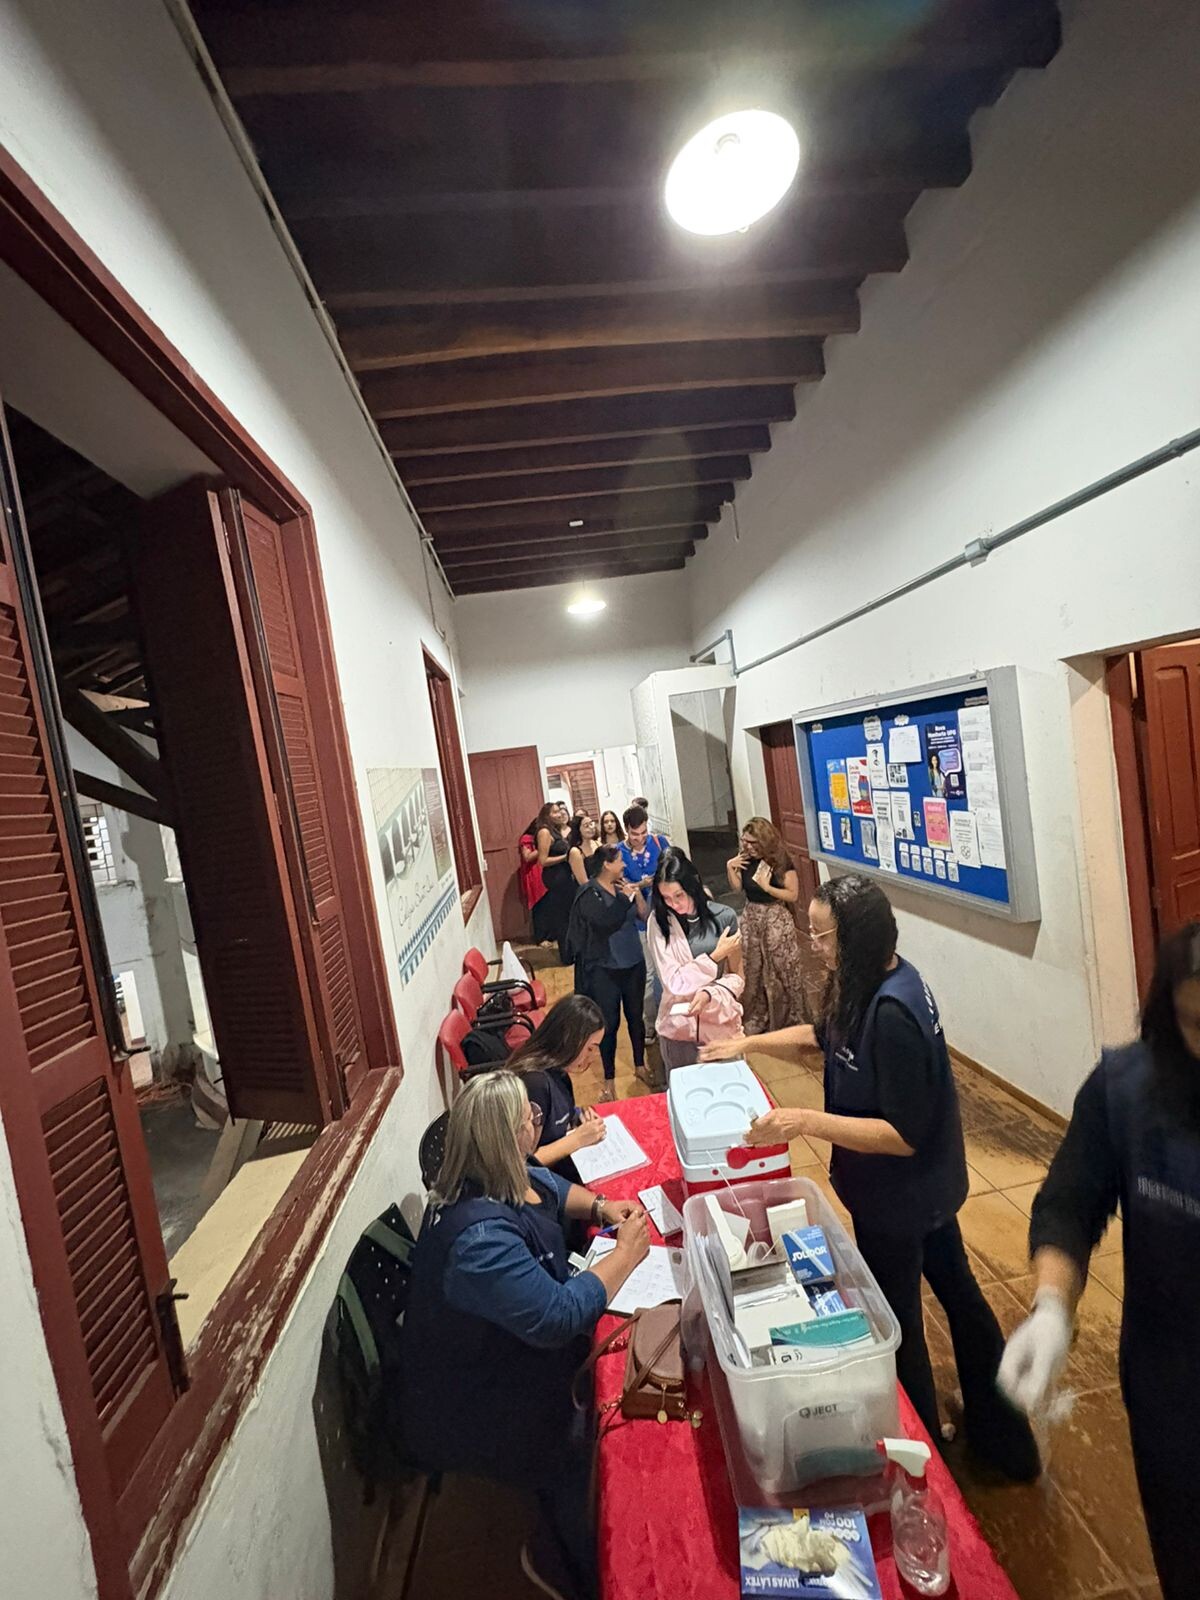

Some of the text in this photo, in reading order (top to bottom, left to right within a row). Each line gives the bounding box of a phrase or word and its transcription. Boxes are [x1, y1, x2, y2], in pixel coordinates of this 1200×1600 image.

[835, 1517, 857, 1529] 100
[745, 1576, 771, 1590] LÁTEX
[771, 1577, 800, 1589] LUVAS
